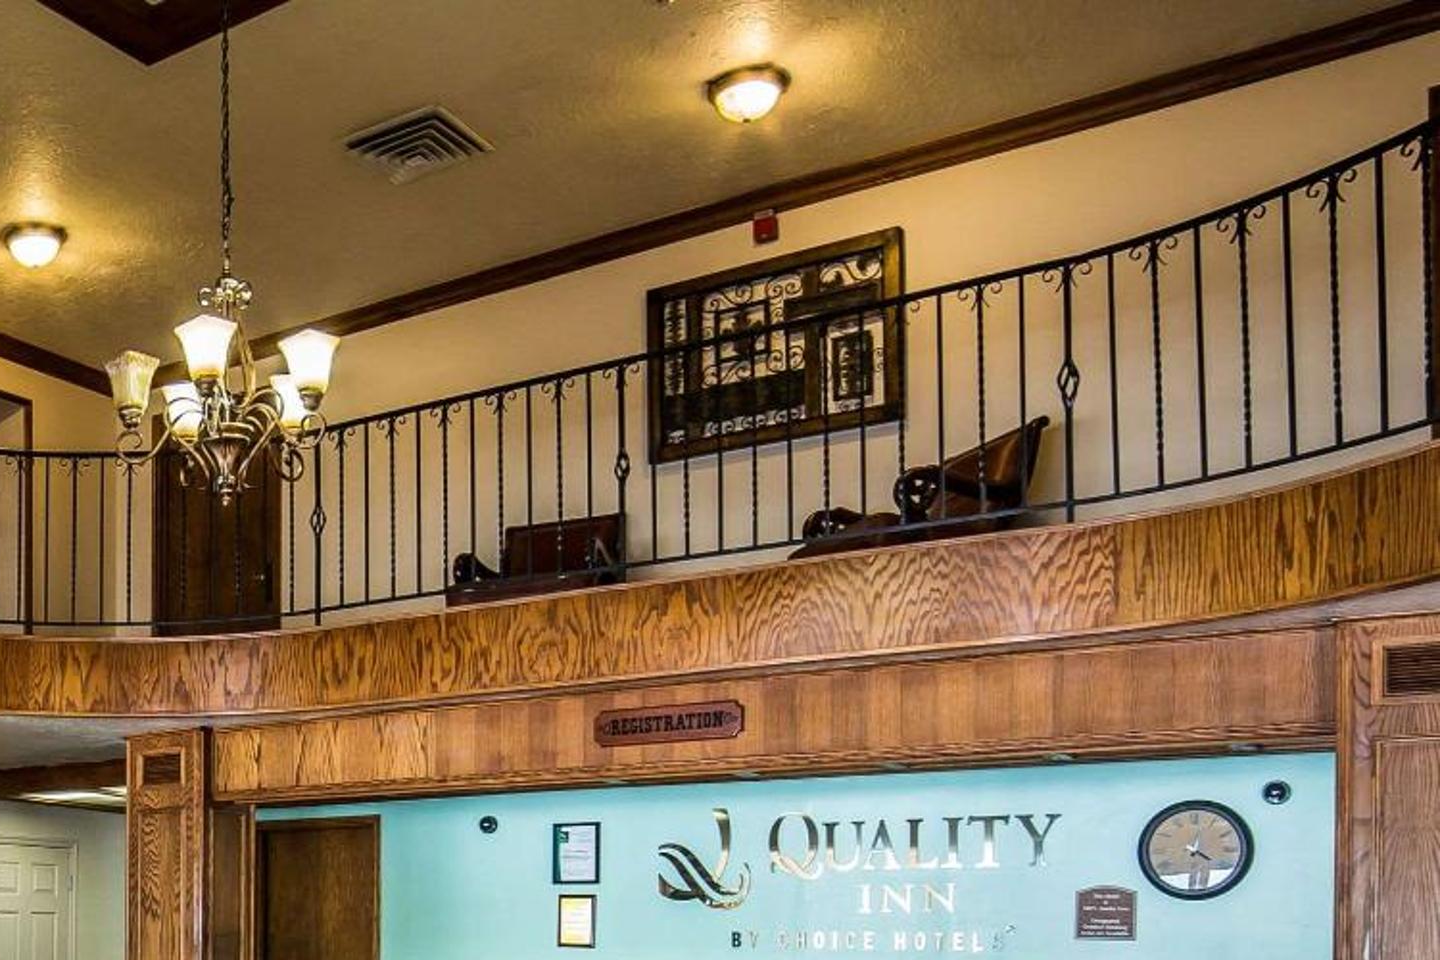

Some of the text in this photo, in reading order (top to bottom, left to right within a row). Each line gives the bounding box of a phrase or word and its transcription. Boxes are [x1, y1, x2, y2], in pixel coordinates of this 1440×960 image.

[611, 710, 724, 736] REGISTRATION
[768, 811, 1062, 880] QUALITY
[854, 881, 956, 914] INN
[731, 930, 1005, 951] BY CHOICE HOTELS
